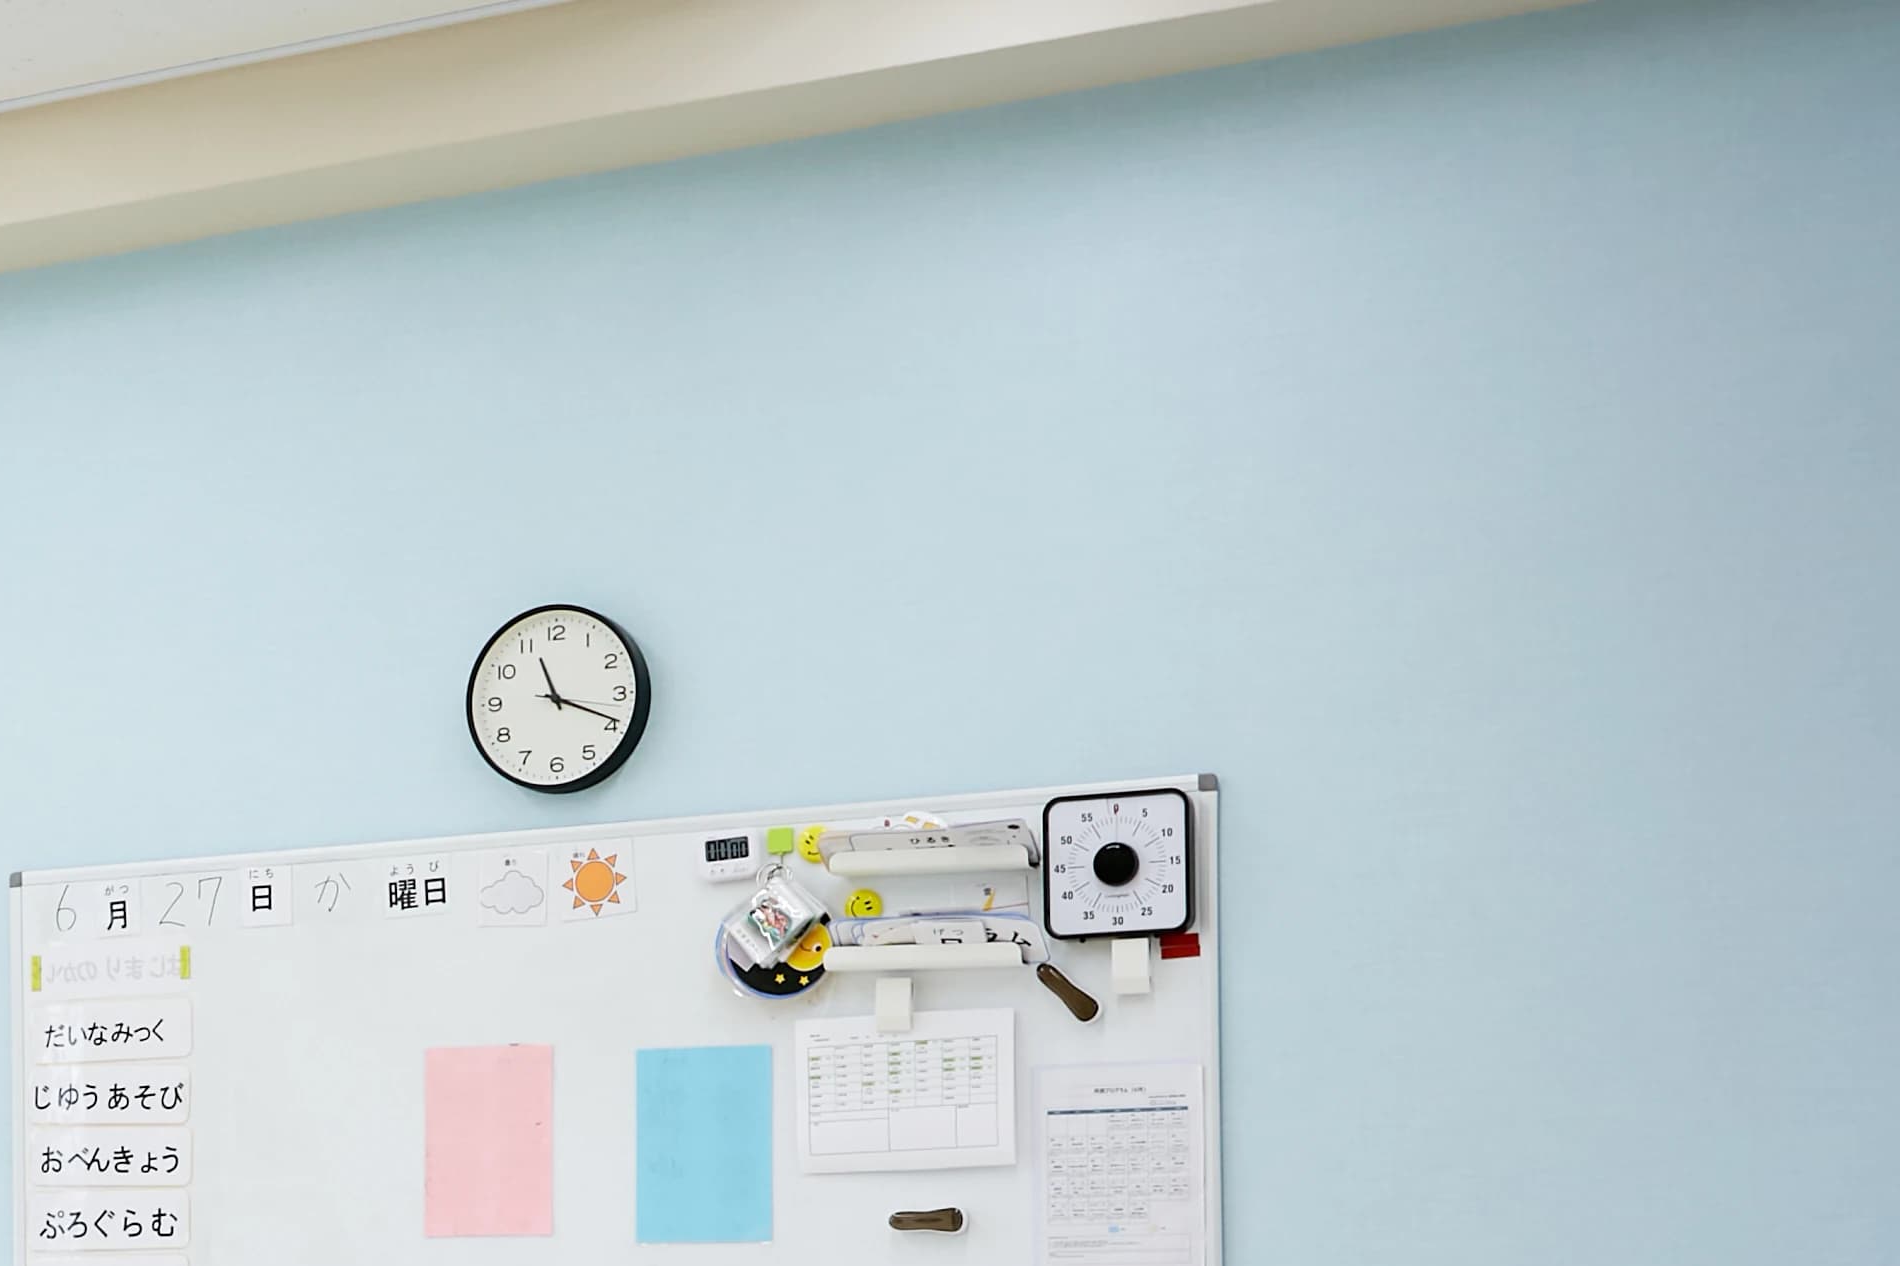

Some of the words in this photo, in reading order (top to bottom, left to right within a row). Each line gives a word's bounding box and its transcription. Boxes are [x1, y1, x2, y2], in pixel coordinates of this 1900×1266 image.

[547, 624, 565, 641] 12
[519, 637, 532, 654] 11
[604, 652, 618, 669] 2
[497, 663, 516, 680] 10
[612, 685, 627, 701] 3
[487, 696, 502, 712] 9
[603, 719, 619, 733] 4
[496, 726, 511, 743] 8
[517, 749, 532, 765] 7
[581, 744, 595, 760] 5
[549, 756, 564, 772] 6
[1080, 812, 1092, 822] 55
[1161, 827, 1172, 836] 10
[1060, 835, 1073, 845] 50
[1169, 855, 1181, 865] 15
[248, 867, 274, 880] にち
[1053, 864, 1066, 874] 45
[104, 884, 130, 897] がつ
[1061, 890, 1074, 901] 40
[1161, 883, 1174, 894] 20
[56, 884, 77, 932] 6
[106, 899, 128, 932] 月
[158, 876, 223, 927] 27
[251, 884, 273, 912] 日
[314, 872, 352, 913] か
[388, 876, 447, 911] 曜日
[1083, 910, 1095, 921] 35
[1140, 906, 1153, 917] 25
[1112, 916, 1124, 926] 30
[45, 1019, 164, 1049] だいなみっく
[40, 1145, 180, 1174] おべんきょう
[39, 1208, 179, 1240] ぷろぐらむ
